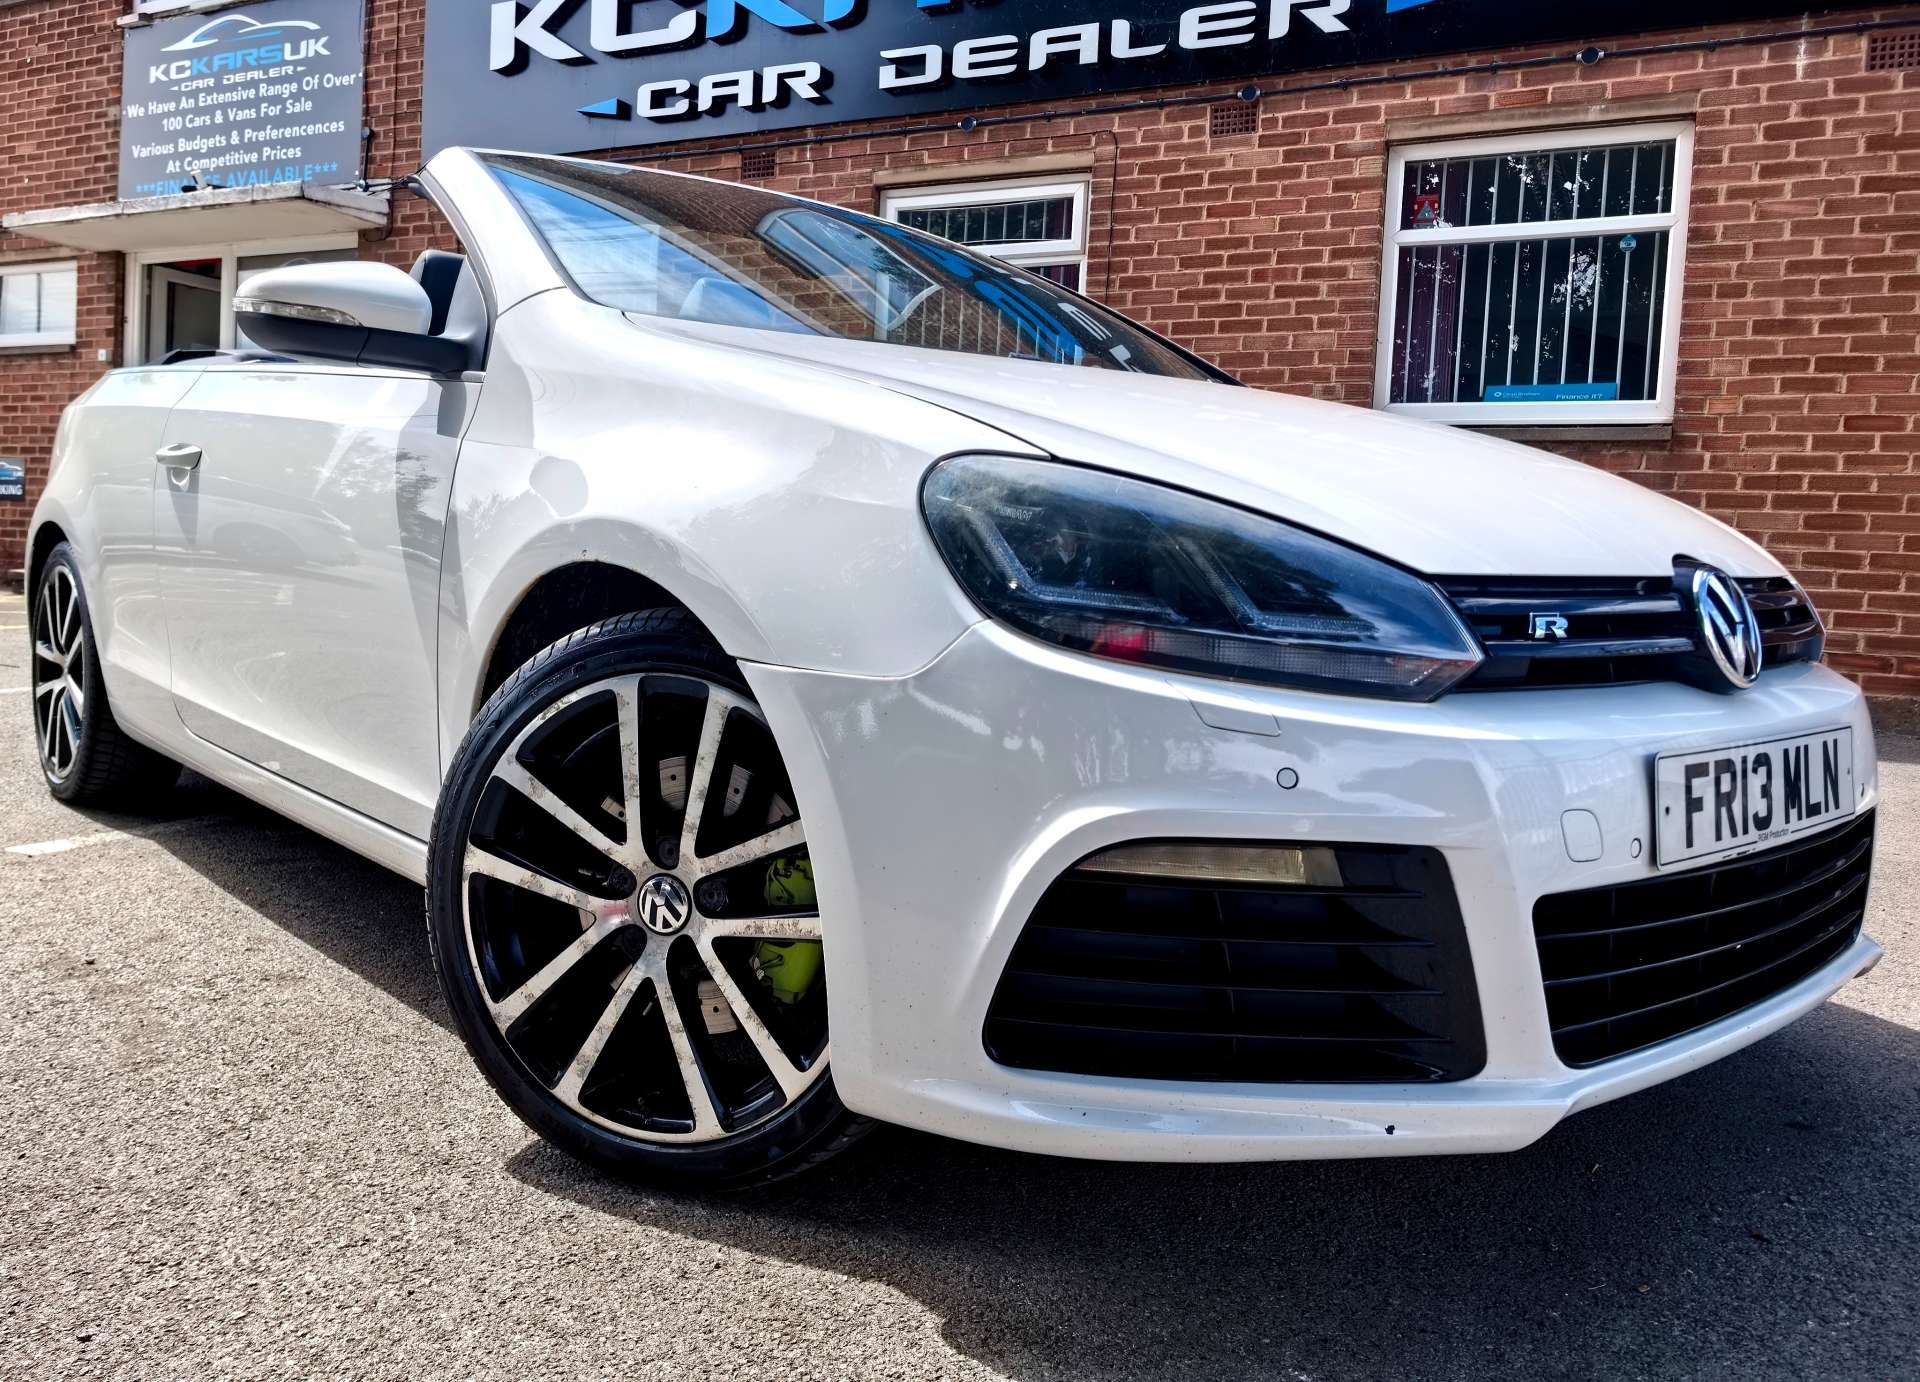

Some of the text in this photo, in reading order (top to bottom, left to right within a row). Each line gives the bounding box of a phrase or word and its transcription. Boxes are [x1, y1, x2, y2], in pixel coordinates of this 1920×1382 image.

[149, 36, 331, 84] KCKARSUK
[181, 65, 294, 92] CAR DEALER
[637, 61, 821, 118] CAR
[879, 0, 1350, 89] DEALER
[127, 73, 356, 118] We Have An Extensive Range Of Over
[162, 97, 312, 131] 100 Cars & Vans For Sale
[132, 119, 345, 159] Various Budgets & Preferencences
[166, 146, 302, 174] At Competitive Prices
[1684, 738, 1840, 849] FR13 MLN
